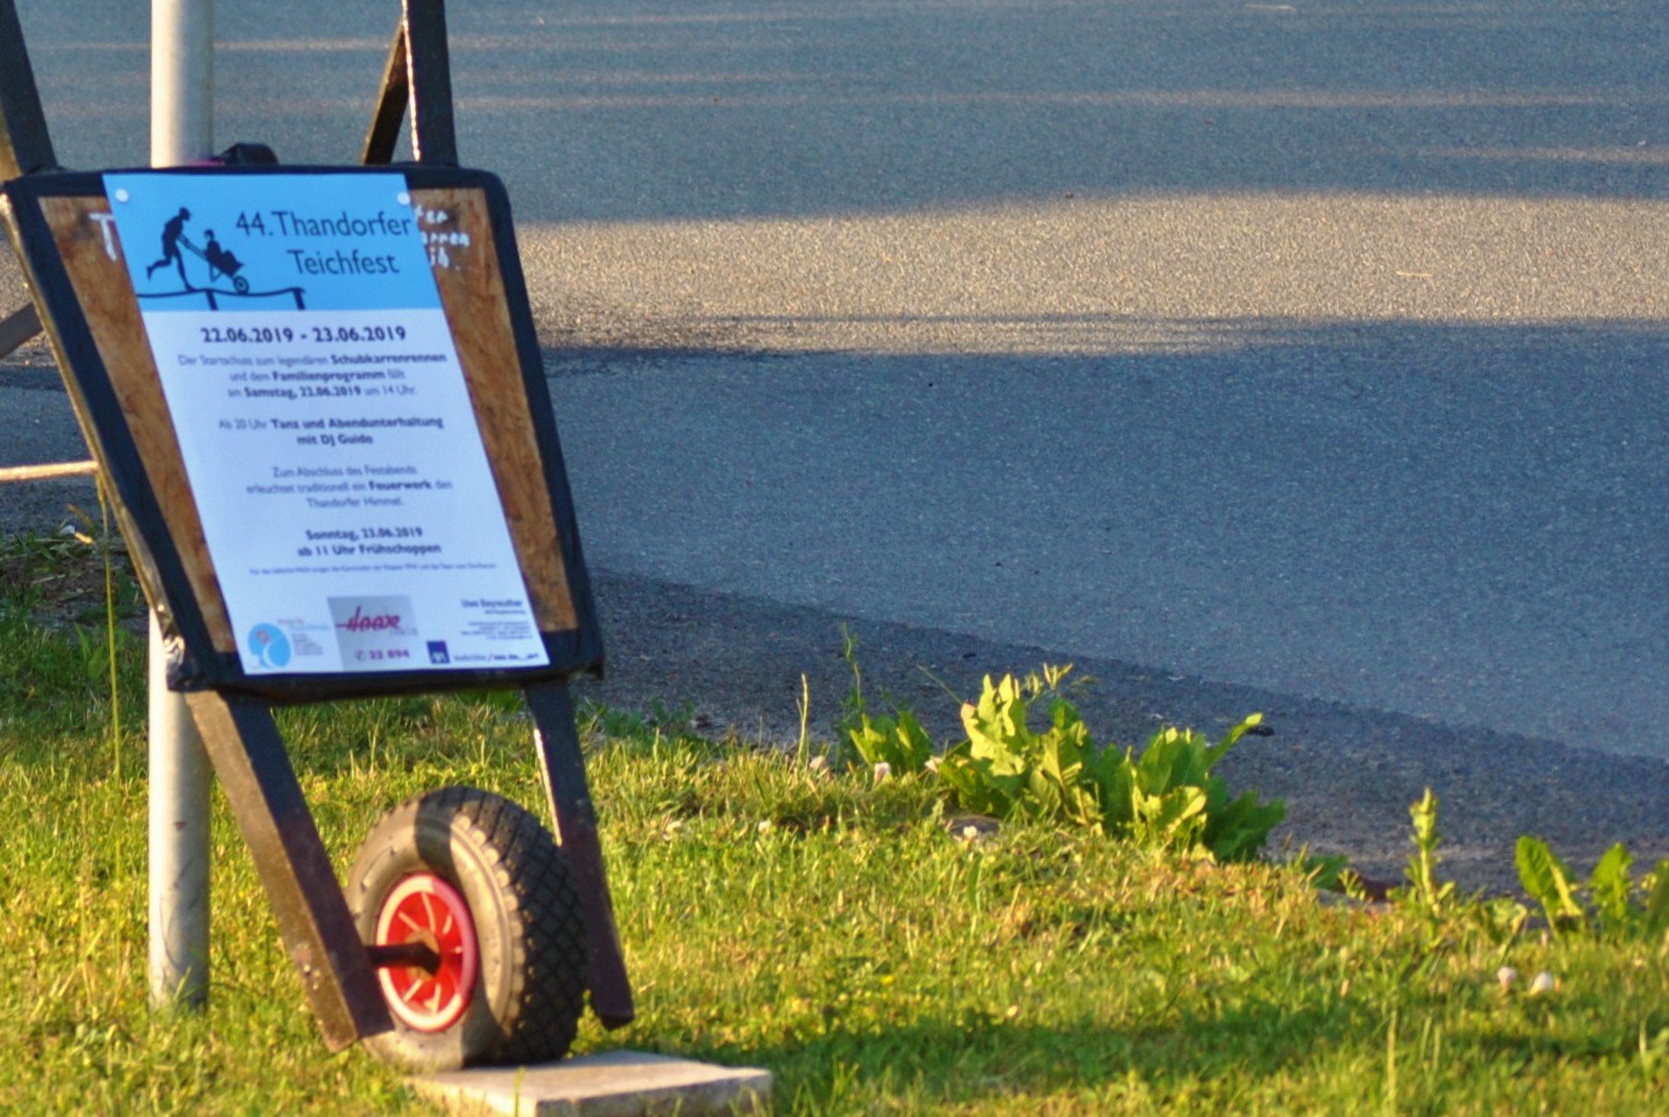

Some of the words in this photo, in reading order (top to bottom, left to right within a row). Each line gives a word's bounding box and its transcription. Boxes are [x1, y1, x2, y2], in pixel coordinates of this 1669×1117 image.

[287, 249, 401, 276] Teichfest
[200, 327, 294, 344] 22.06.2019
[312, 326, 407, 343] 23.06.2019
[330, 352, 448, 365] Schubkarrenrennen
[272, 369, 385, 384] Familienprogramm
[244, 386, 298, 400] Samstag,
[300, 386, 362, 397] 22.06.2019
[271, 418, 299, 430] Tanz
[302, 418, 325, 429] und
[328, 416, 444, 430] Abendunterhaltung
[297, 434, 318, 445] mit
[338, 433, 374, 445] Guido
[368, 480, 432, 491] Feuerwerk
[305, 527, 360, 542] Sonntag,
[362, 526, 423, 539] 23.06.2019
[297, 545, 313, 557] ab
[315, 545, 330, 557] 11
[331, 544, 356, 556] Uhr
[358, 542, 442, 557] Frühschoppen
